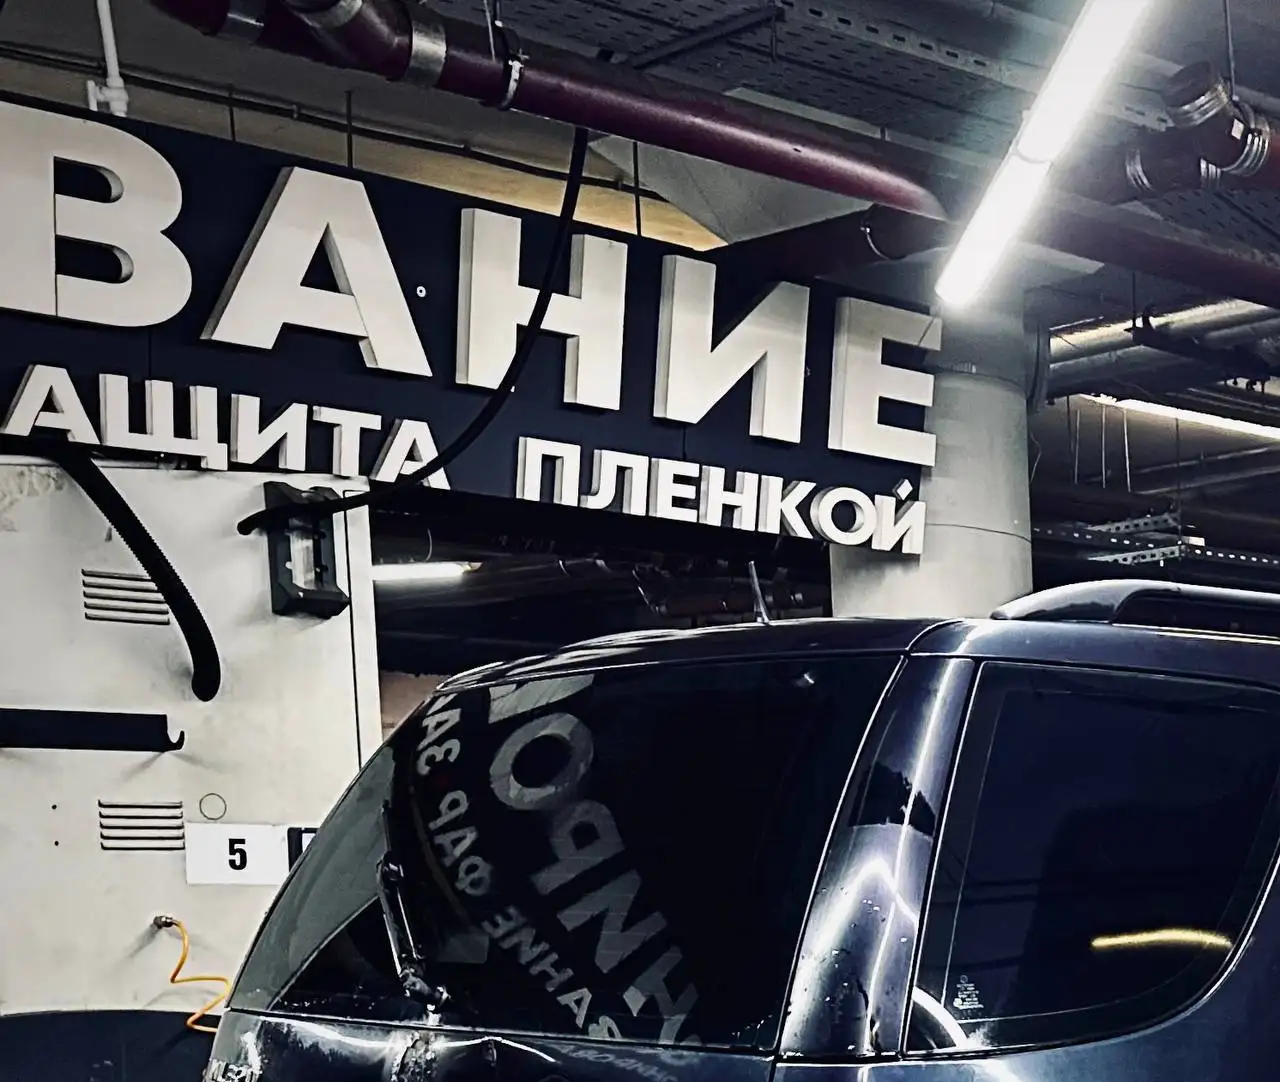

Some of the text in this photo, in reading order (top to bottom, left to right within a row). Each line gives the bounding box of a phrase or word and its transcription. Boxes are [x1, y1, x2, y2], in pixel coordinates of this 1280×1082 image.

[0, 102, 942, 467] ВАНИЕ
[0, 364, 927, 554] АЩИТА ПЛЕНКОЙ
[228, 838, 247, 870] 5
